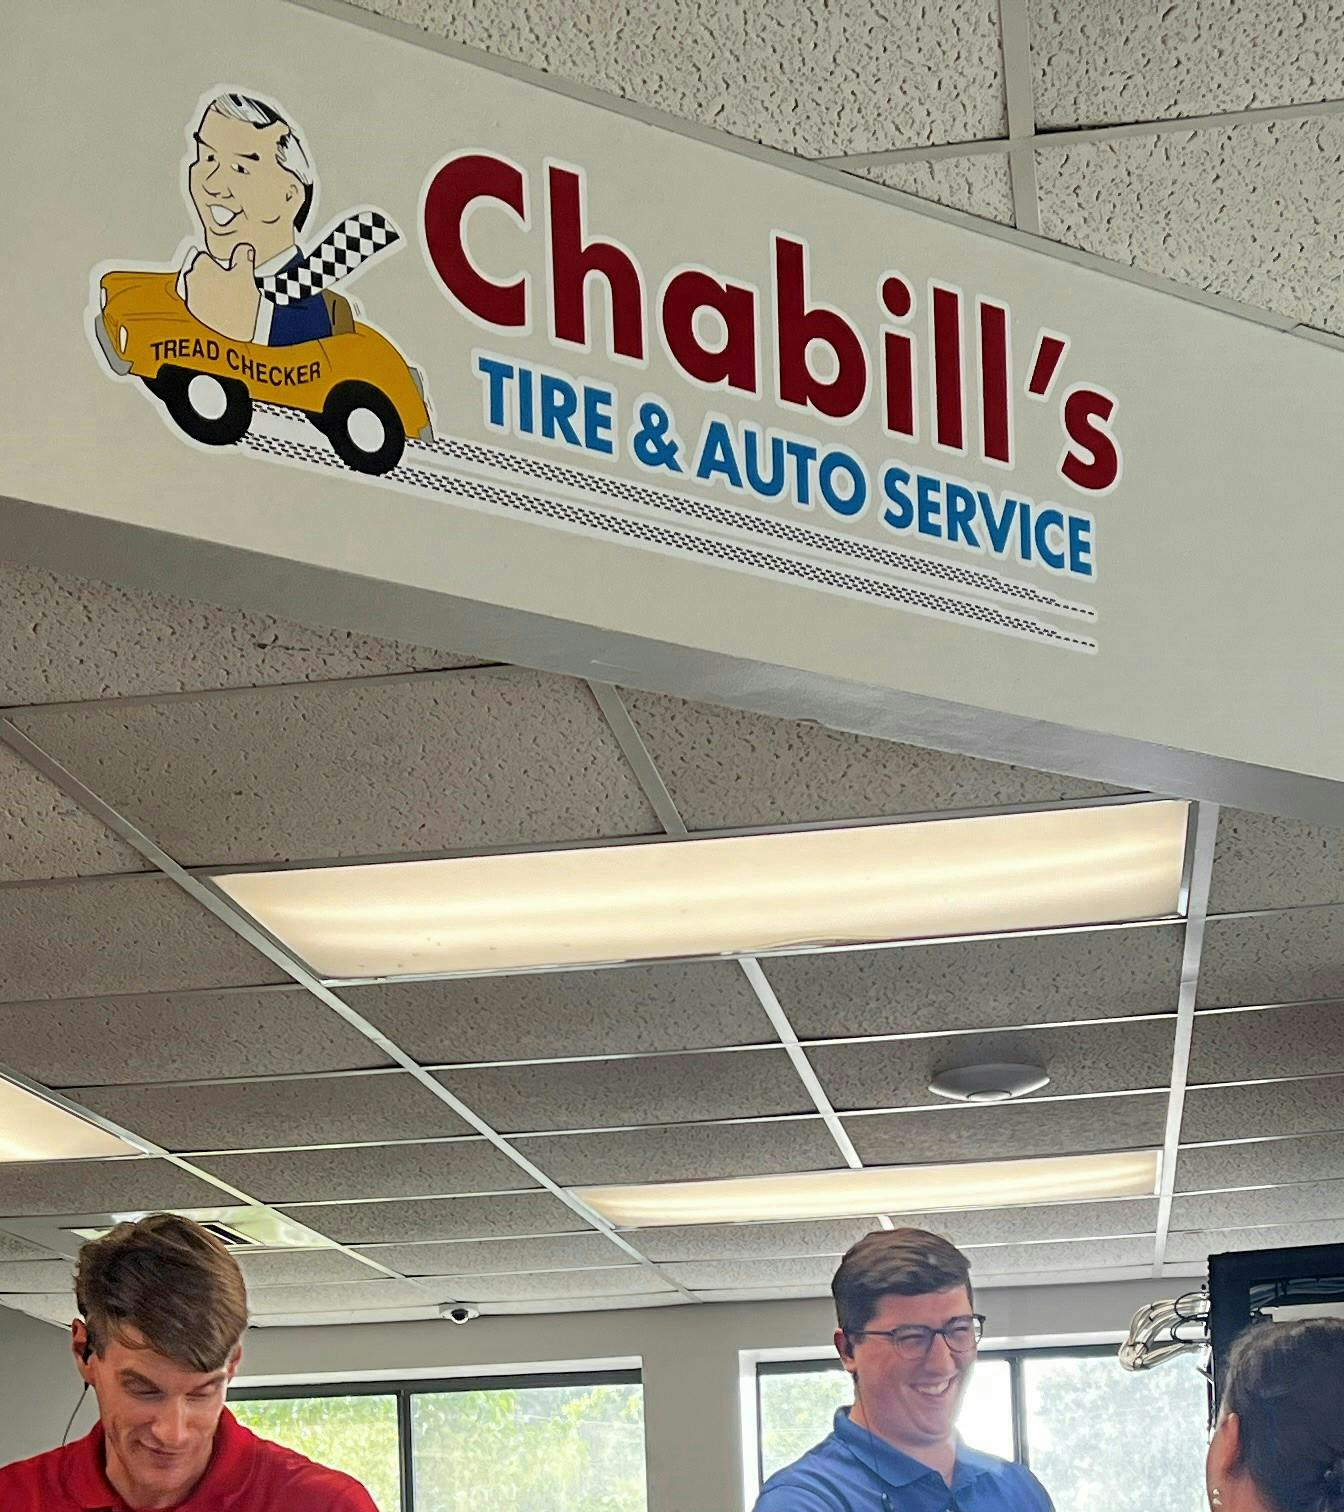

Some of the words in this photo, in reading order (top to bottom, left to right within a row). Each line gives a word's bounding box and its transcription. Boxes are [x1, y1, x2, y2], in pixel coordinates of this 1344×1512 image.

[150, 339, 220, 361] TREAD
[226, 348, 321, 387] CHECKER
[424, 154, 1120, 490] Chabill's
[479, 357, 613, 455] TIRE
[633, 401, 683, 473] &
[697, 421, 867, 516] AUTO
[883, 467, 1094, 577] SERVICE
